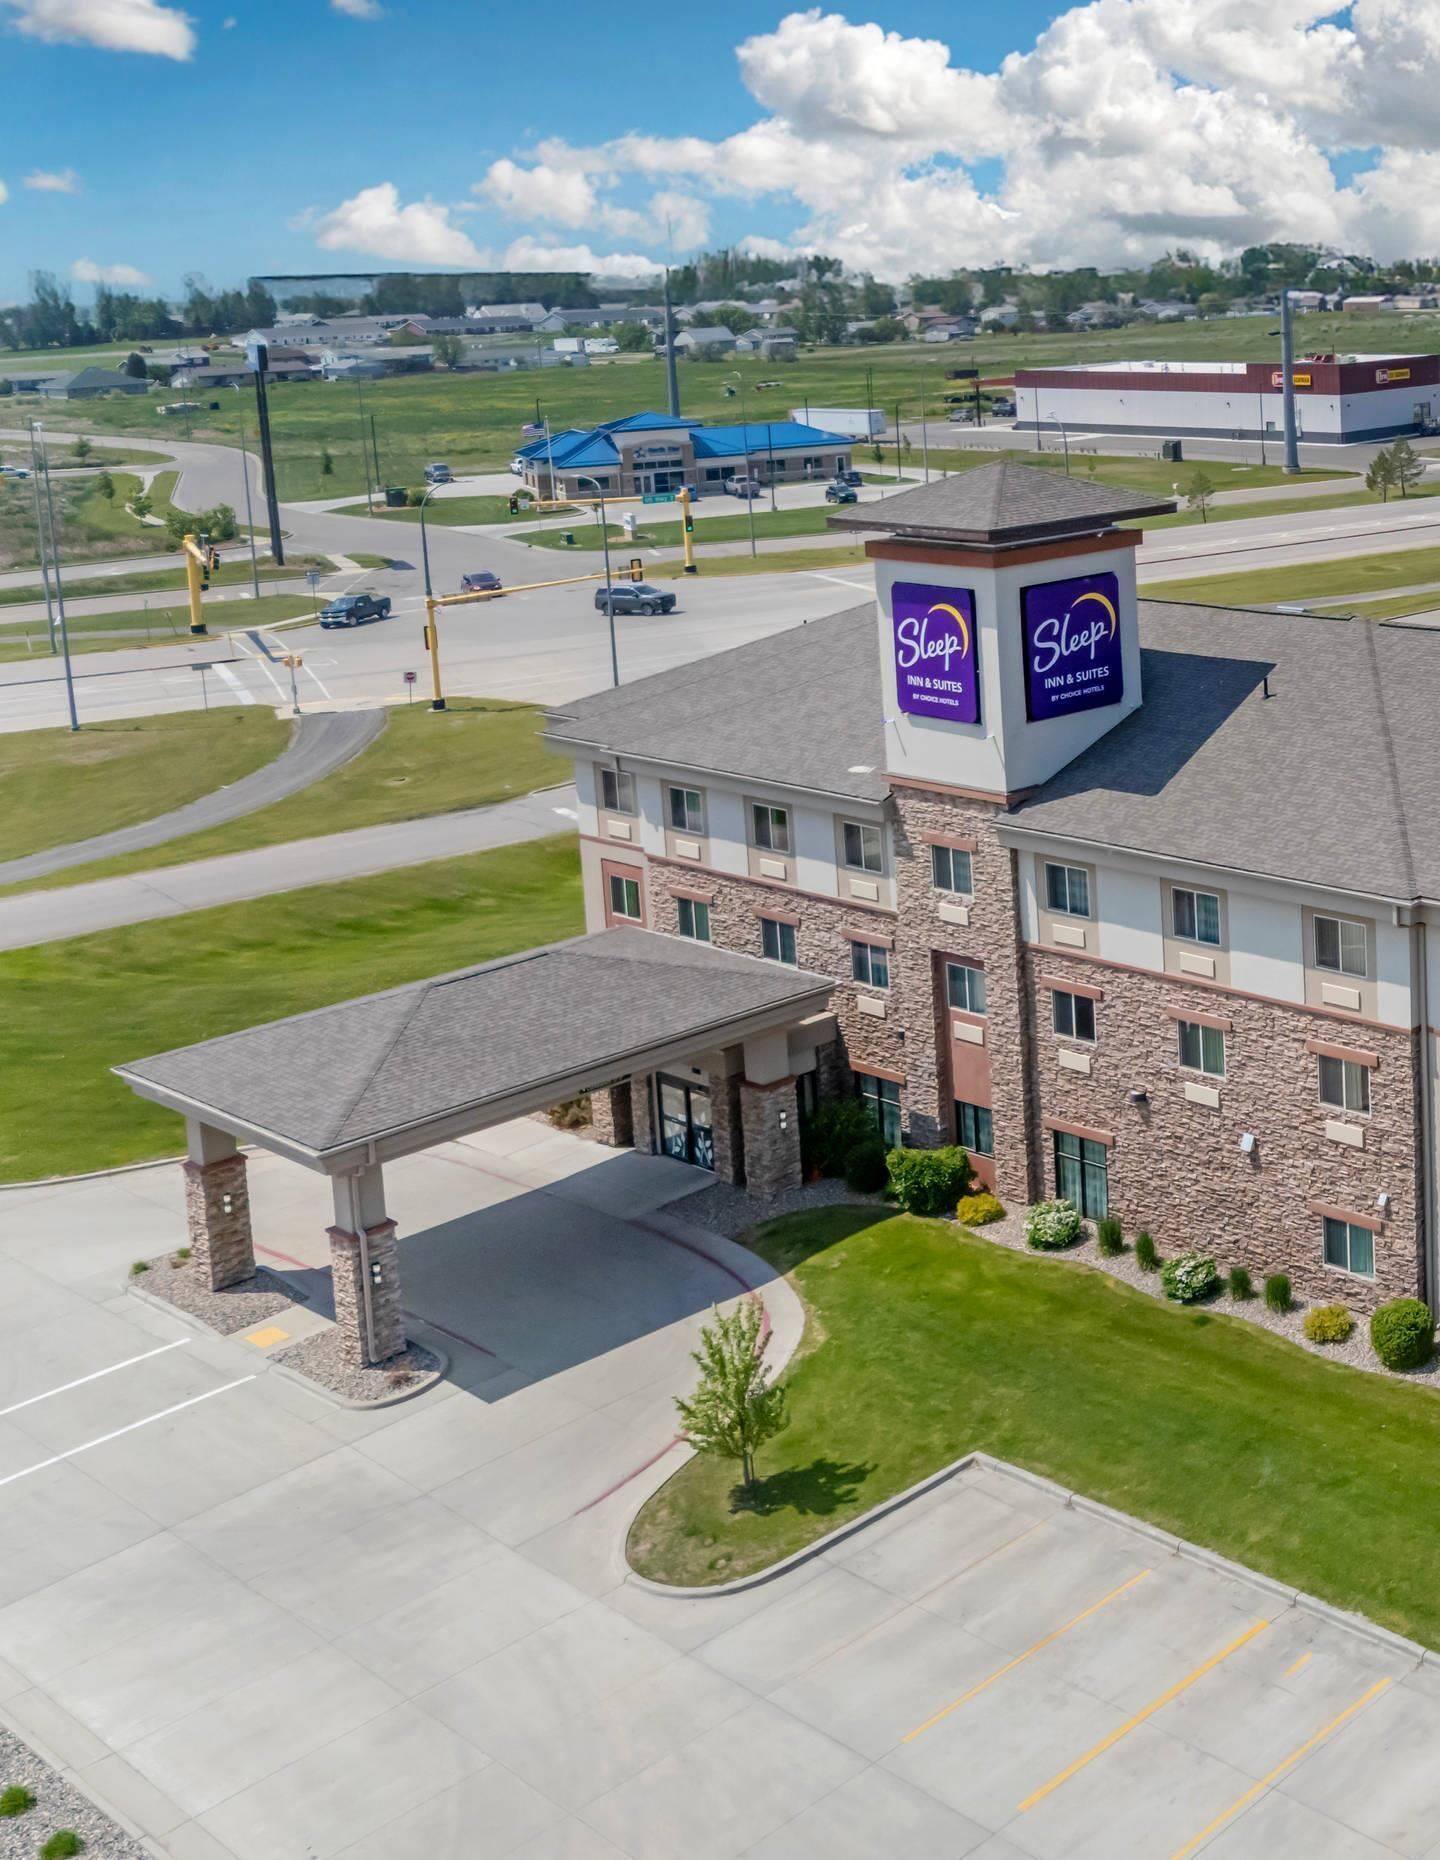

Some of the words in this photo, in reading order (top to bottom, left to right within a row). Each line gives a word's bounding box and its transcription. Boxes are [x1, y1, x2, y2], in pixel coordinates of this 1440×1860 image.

[897, 617, 962, 671] Sleep
[1033, 613, 1109, 673] Sleep
[907, 674, 923, 687] INN
[925, 678, 932, 689] &
[932, 679, 963, 693] SUITES
[1044, 676, 1064, 689] INN
[1066, 674, 1074, 684] &
[1076, 666, 1110, 682] SUITES
[920, 695, 938, 704] CHOICE
[939, 698, 959, 706] HOTELS
[1051, 694, 1059, 702] BY
[1060, 690, 1082, 700] CHOICE
[1083, 685, 1105, 694] HOTELS
